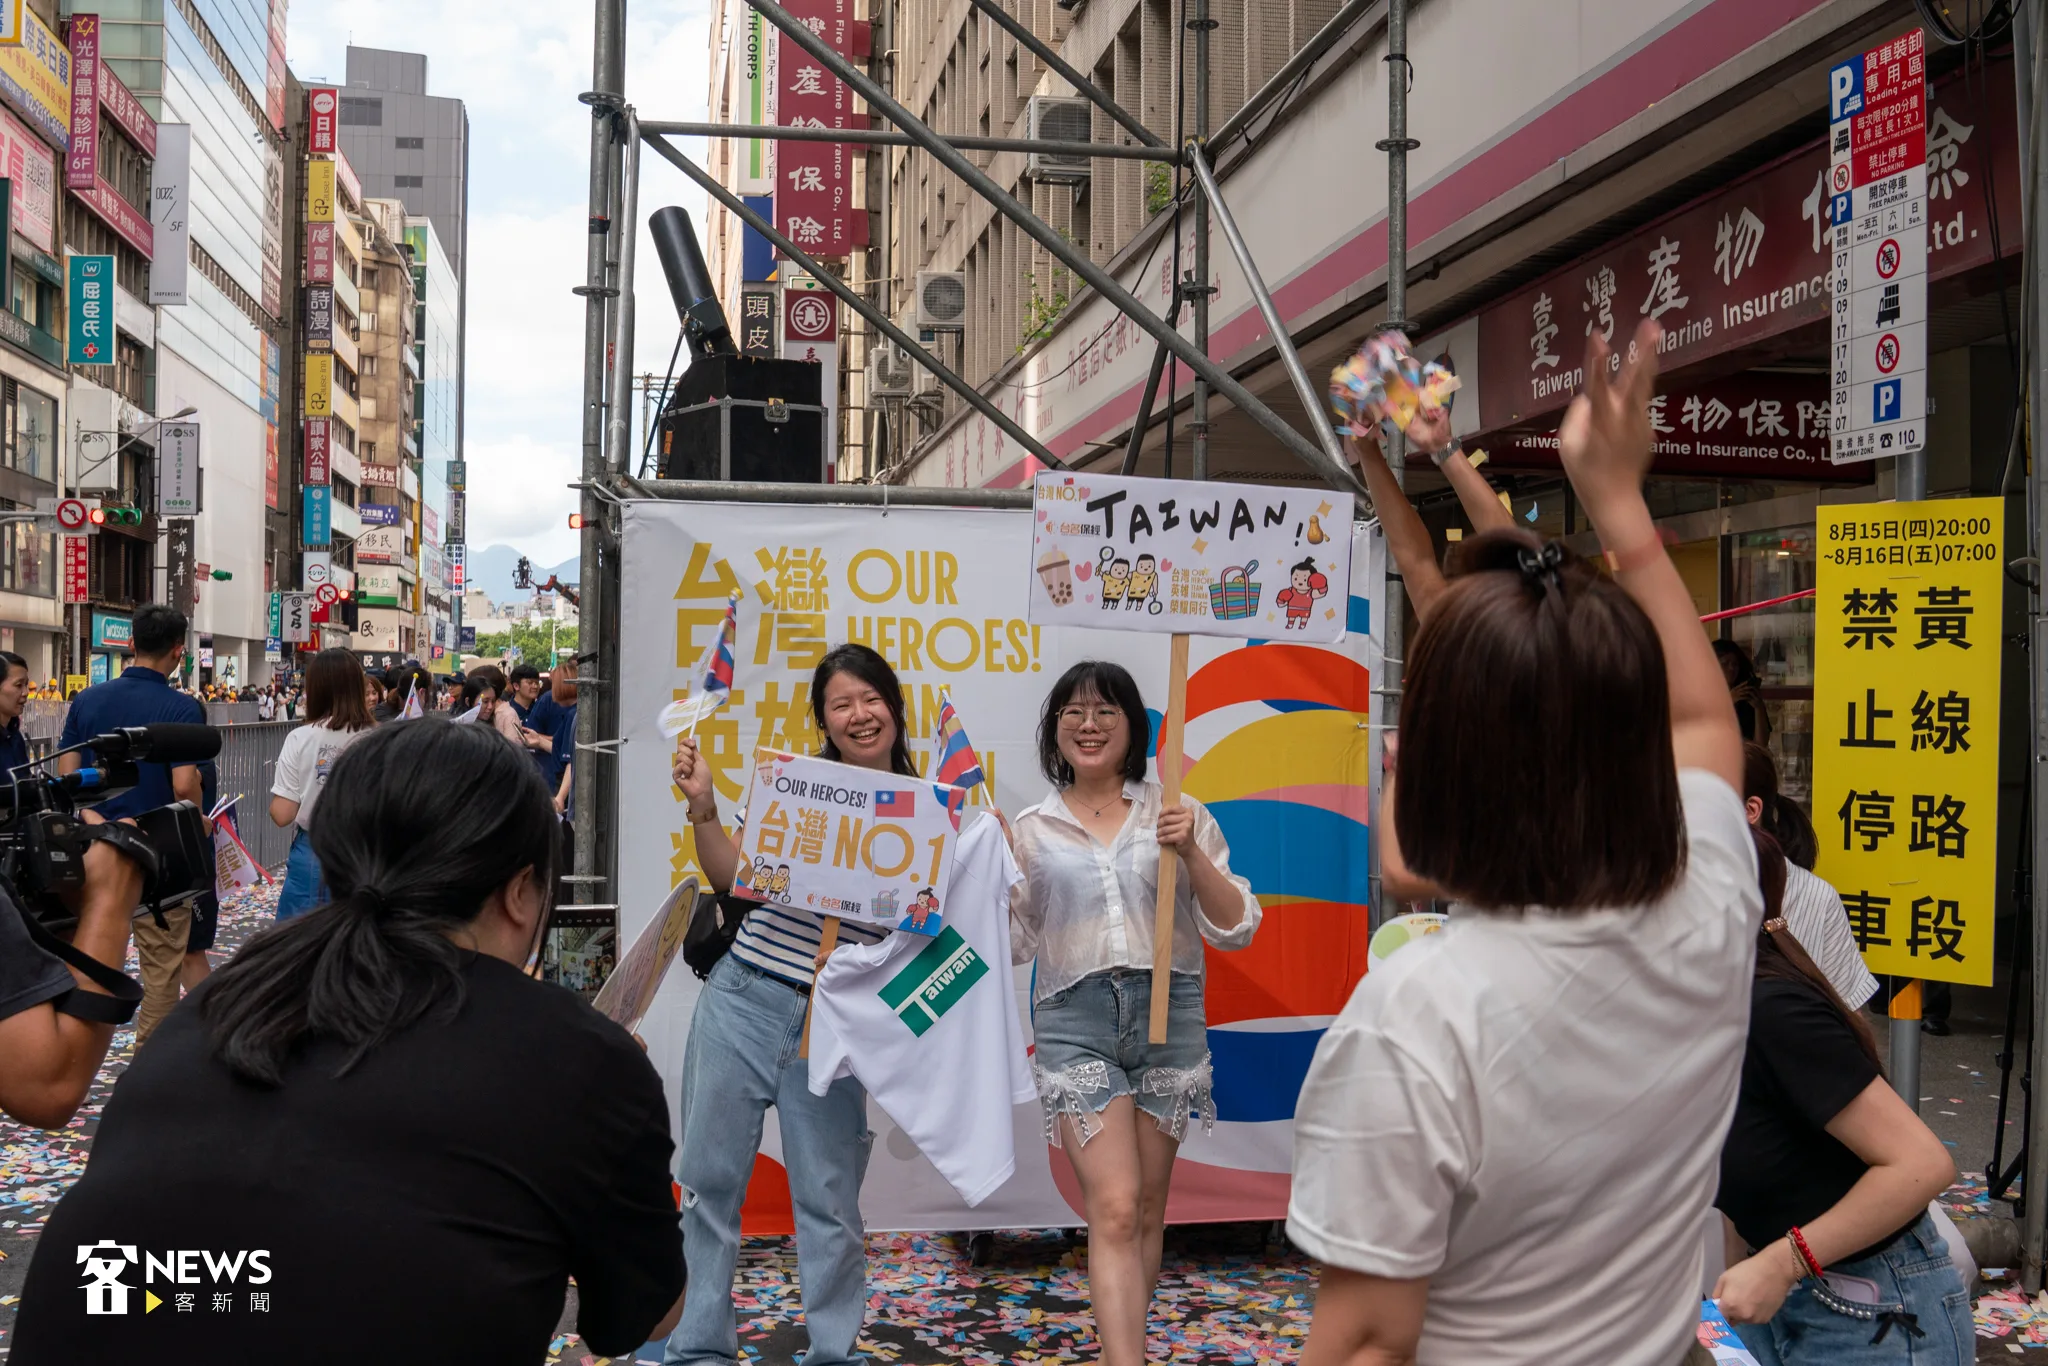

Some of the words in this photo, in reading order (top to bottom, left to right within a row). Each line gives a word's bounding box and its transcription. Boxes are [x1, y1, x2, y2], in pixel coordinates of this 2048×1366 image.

[835, 20, 845, 44] Fire
[747, 34, 759, 80] CORPS
[1865, 31, 1923, 74] 貨車裝卸
[1866, 53, 1923, 94] 專用區
[835, 77, 844, 110] arine
[1866, 86, 1898, 105] Loading
[1902, 76, 1922, 91] Zone
[135, 110, 145, 135] 6F
[1856, 94, 1919, 130] 每次限停20分鐘
[315, 116, 331, 149] 日語
[1900, 122, 1924, 136] EXTENSION
[835, 116, 844, 180] Inrance
[1868, 143, 1908, 170] 禁止停車
[72, 157, 91, 170] 6F
[1871, 168, 1880, 179] NO
[1880, 160, 1905, 176] PARKING
[1868, 174, 1908, 201] 開放停車
[1868, 199, 1883, 211] FREE
[1883, 191, 1909, 207] PARKING
[1911, 202, 1919, 214] 日
[169, 221, 183, 232] 5F
[1857, 214, 1878, 230] 一至五
[1889, 208, 1898, 221] 六
[833, 218, 843, 245] Ltd.
[1836, 236, 1848, 248] 時間
[313, 246, 329, 279] 富豪
[1836, 252, 1848, 269] 07
[1836, 278, 1848, 294] 09
[82, 281, 101, 338] 屈臣氏
[310, 290, 331, 330] 詩漫
[1531, 366, 1583, 400] Taiwan
[1628, 340, 1639, 364] &
[1723, 272, 1833, 330] Insurance
[1927, 210, 1978, 254] td.
[1836, 297, 1848, 314] 09
[746, 295, 769, 349] 頭皮
[1836, 324, 1847, 340] 17
[1836, 344, 1847, 361] 17
[1835, 371, 1847, 386] 20
[1835, 389, 1847, 406] 20
[1835, 415, 1847, 431] 07
[1898, 429, 1915, 446] 110
[310, 420, 325, 482] 讀家公職
[1649, 440, 1691, 456] arine
[1696, 441, 1779, 459] Insurance
[1783, 446, 1816, 464] Co.,
[1860, 446, 1875, 456] ZONE
[1038, 484, 1055, 500] 台灣
[1056, 485, 1083, 502] NO.1
[1060, 521, 1101, 537] 台名保經
[1829, 517, 1991, 542] 8月15日(四)20:00
[1823, 543, 1997, 567] ~8月16日(五)07:00
[291, 607, 302, 629] くら
[311, 603, 324, 613] 2F
[673, 541, 830, 671] 台灣
[847, 547, 959, 606] OUR
[105, 623, 130, 640] watsons
[848, 615, 1041, 674] HEROES!
[1837, 586, 1899, 954] 禁止停車
[1905, 585, 1974, 964] 黃線路段
[775, 776, 806, 798] OUR
[810, 782, 868, 809] HEROES!
[756, 800, 829, 865] 台灣
[832, 814, 946, 886] NO.1
[820, 895, 861, 914] 台名保經
